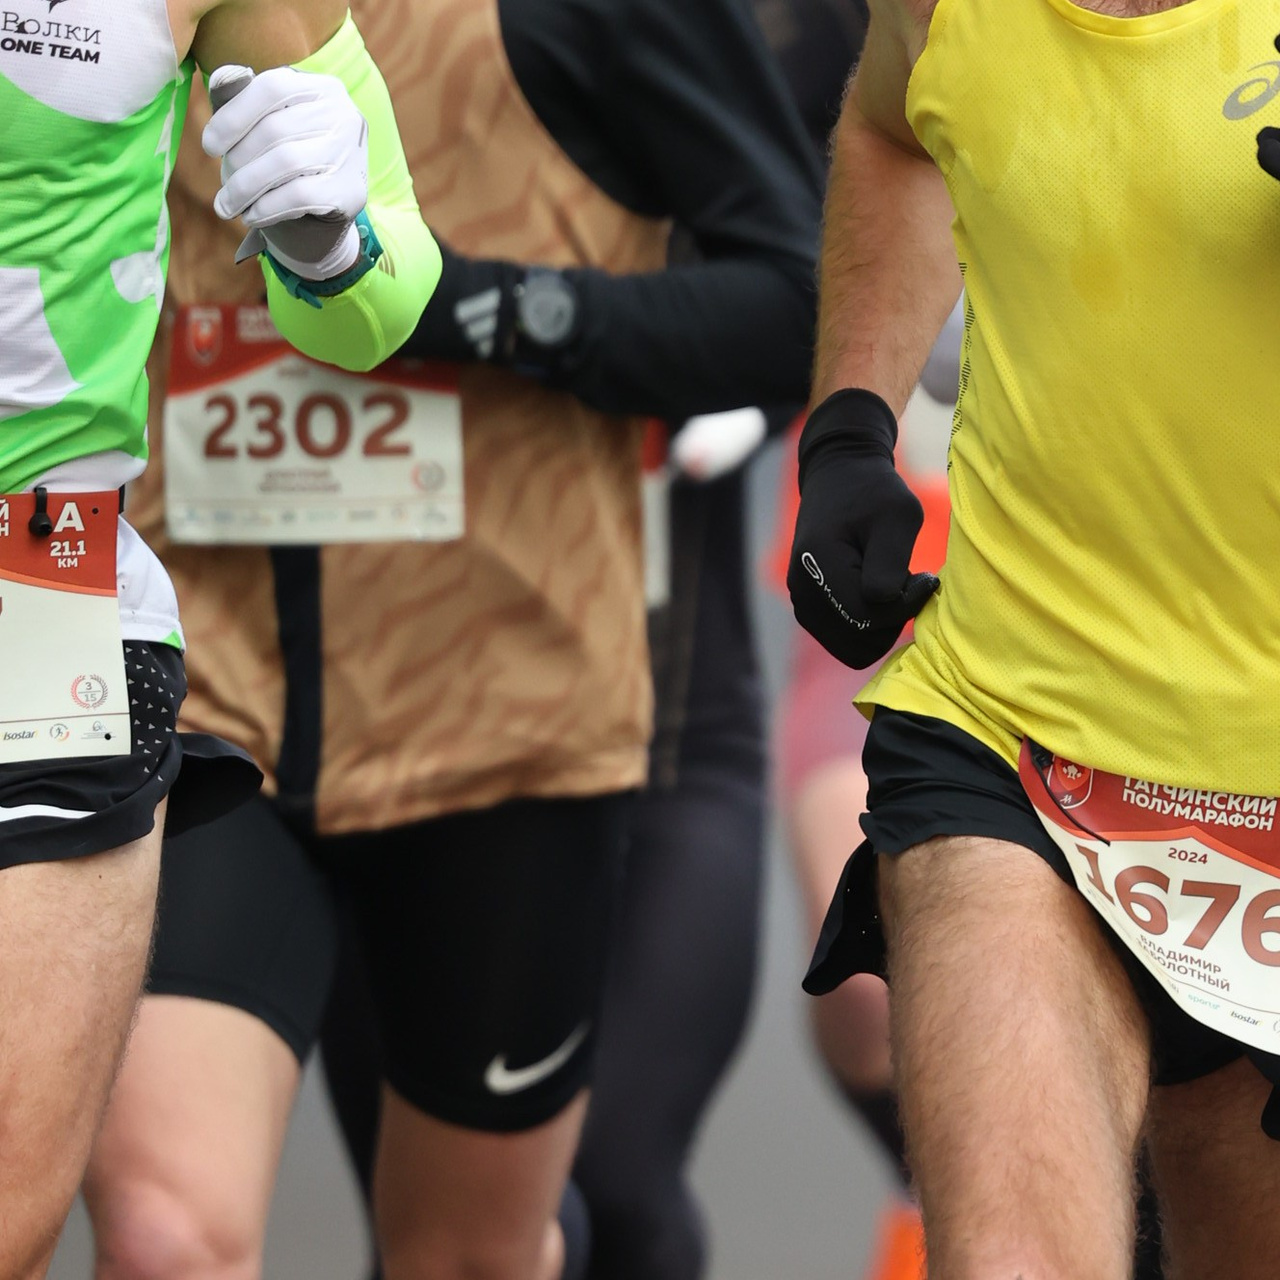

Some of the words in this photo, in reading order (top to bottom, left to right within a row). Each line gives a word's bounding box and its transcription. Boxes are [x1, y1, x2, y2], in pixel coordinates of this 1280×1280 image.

[1, 37, 44, 55] ONE
[48, 43, 100, 64] TEAM
[204, 391, 412, 459] 2302
[50, 540, 86, 556] 21.1
[85, 681, 93, 691] 3
[84, 693, 97, 702] 15
[1122, 788, 1274, 832] ПОЛУМАРАФОН
[1167, 847, 1209, 865] 2024
[1140, 933, 1221, 975] ВЛАДИМИР
